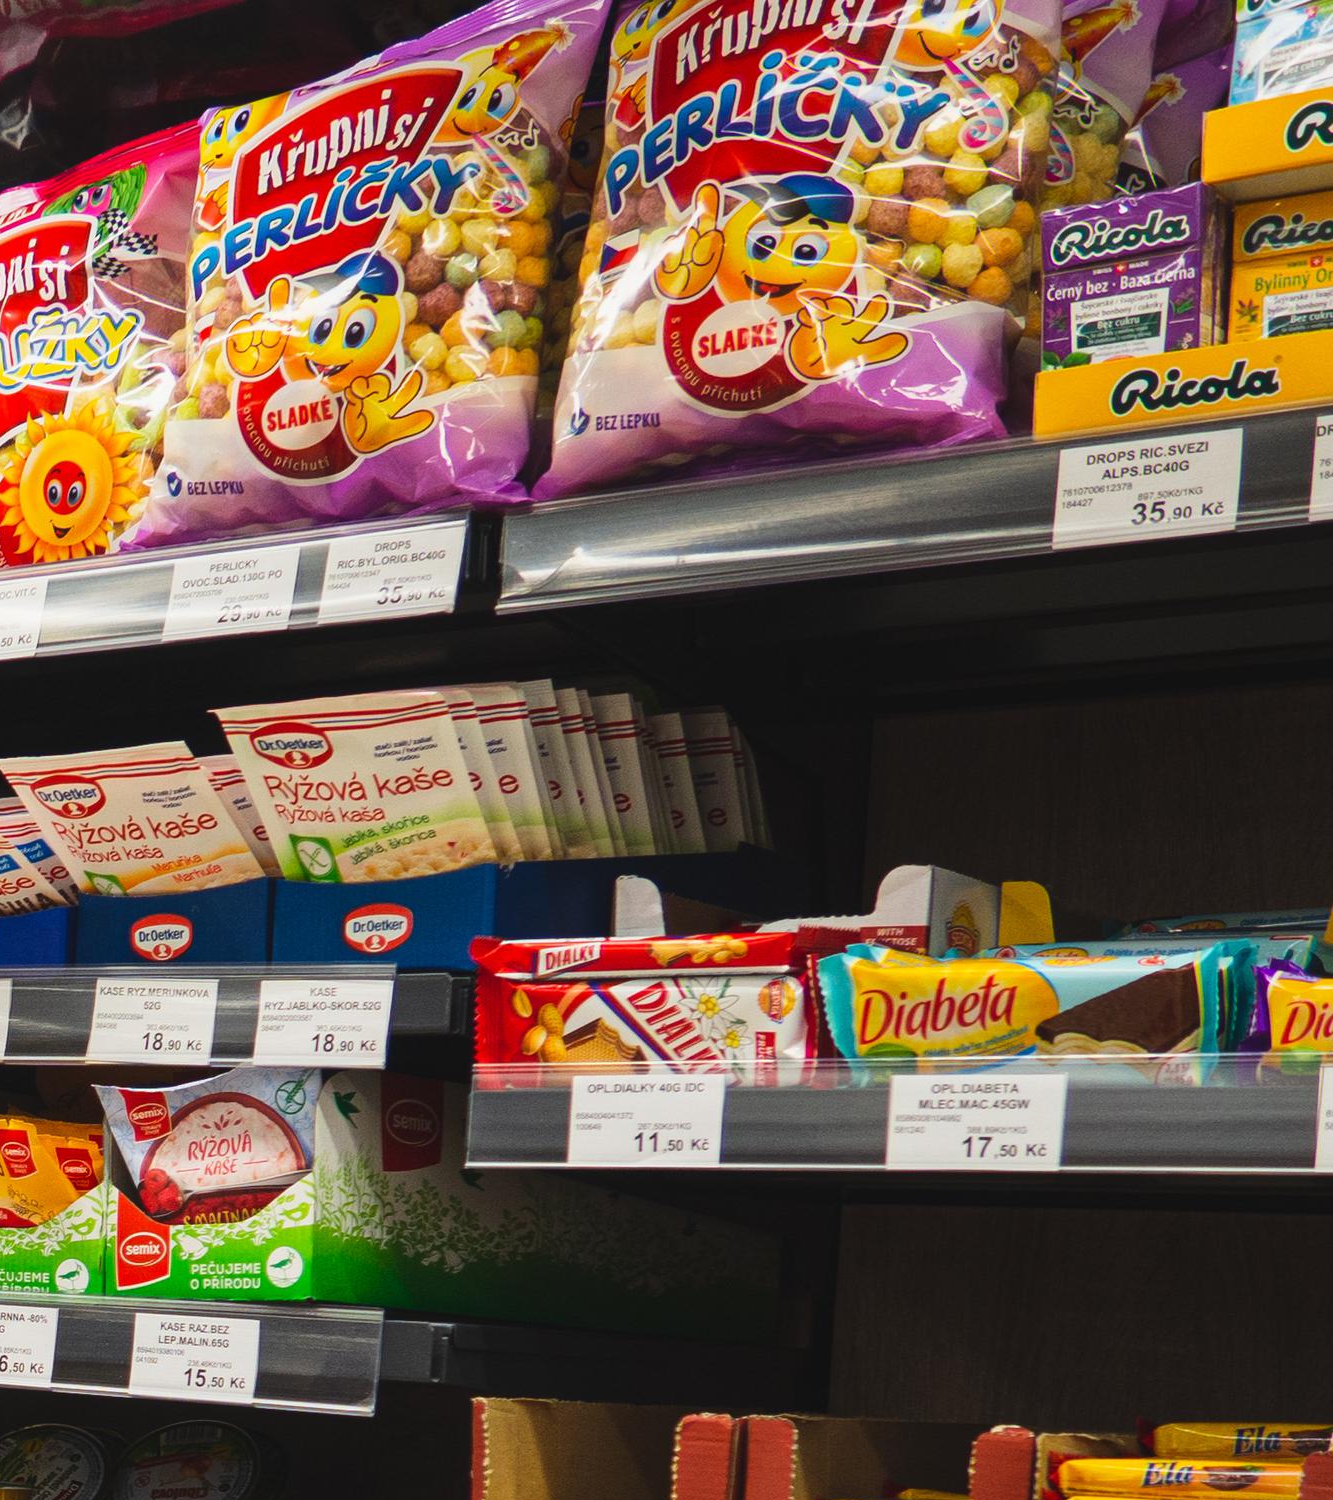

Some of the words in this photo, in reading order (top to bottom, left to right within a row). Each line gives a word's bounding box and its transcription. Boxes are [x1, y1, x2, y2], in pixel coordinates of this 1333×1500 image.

[1052, 212, 1188, 266] Ricola
[1047, 282, 1087, 300] Černý
[1091, 279, 1109, 292] bez
[699, 322, 777, 357] SLADKÉ
[1111, 362, 1279, 415] Ricola
[267, 394, 333, 430] SLADKÉ
[595, 416, 619, 432] BEZ
[1086, 452, 1132, 466] DROPS
[1137, 442, 1210, 462] RIC.SVEZI
[1102, 460, 1190, 481] ALPS.BC40G
[1132, 501, 1194, 528] 35,90
[1200, 500, 1223, 516] Kč
[264, 773, 361, 802] Rýžová
[373, 768, 453, 794] kaše
[352, 919, 404, 934] Dr.Oetker
[858, 977, 1018, 1047] Diabeta
[311, 1032, 354, 1052] 18,90
[361, 1038, 376, 1050] Kč
[932, 1083, 1019, 1094] OPL.DIABETA
[188, 1131, 253, 1159] RÝŽOVÁ
[634, 1132, 684, 1153] 11,50
[690, 1138, 709, 1151] Kč
[203, 1157, 239, 1177] KAŠE
[191, 1262, 261, 1278] PEČUJEME
[190, 1277, 199, 1287] O
[203, 1275, 260, 1290] PŘÍRODU
[160, 1322, 188, 1331] KASE
[183, 1368, 224, 1389] 15,50
[230, 1376, 245, 1389] Kč
